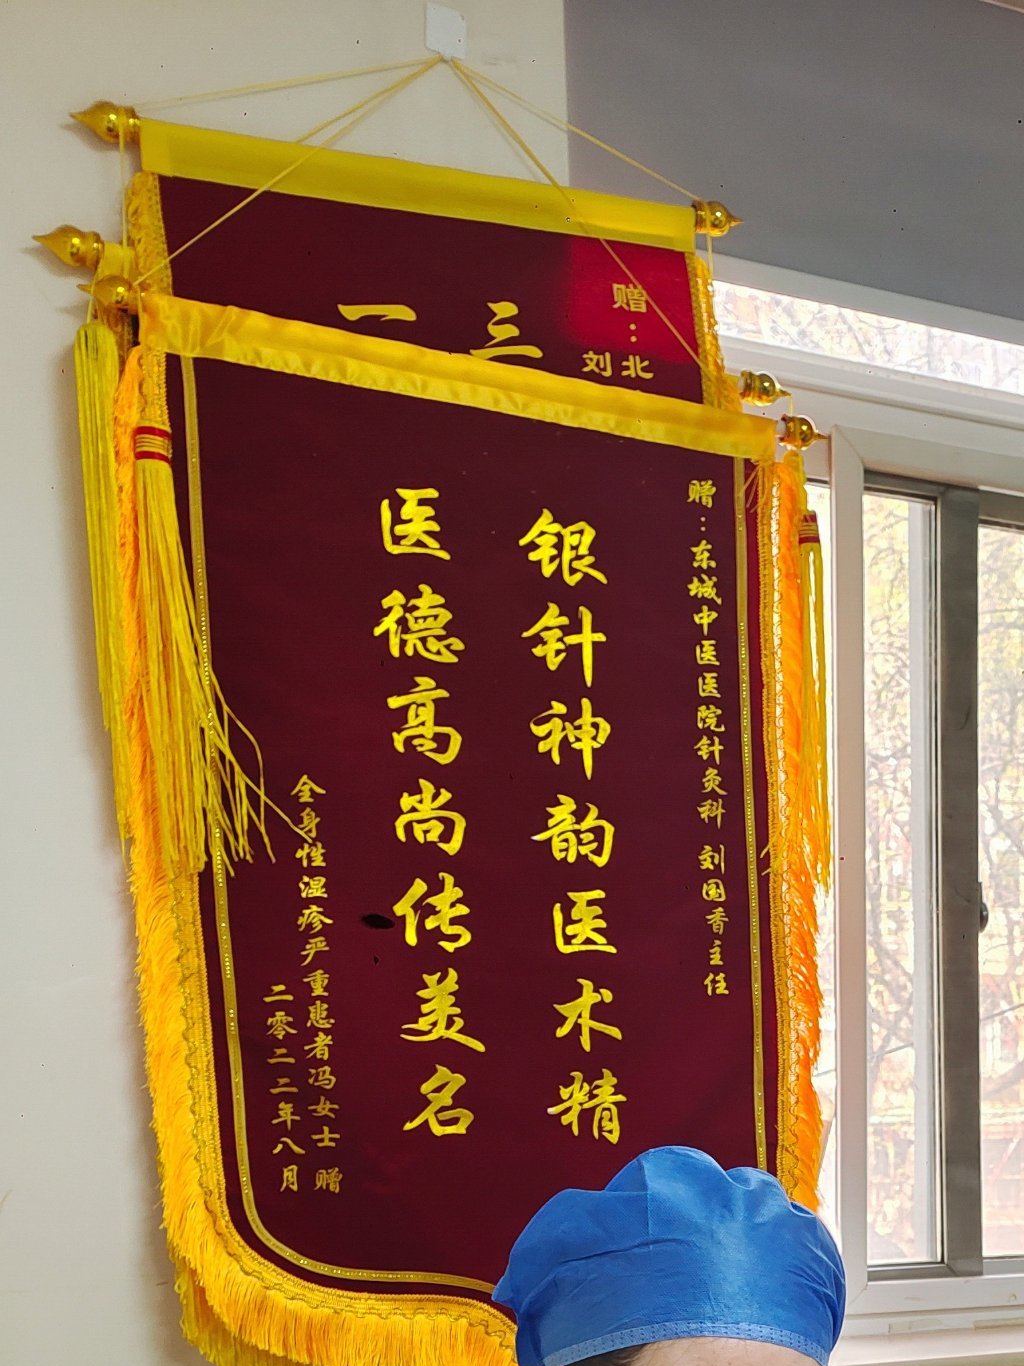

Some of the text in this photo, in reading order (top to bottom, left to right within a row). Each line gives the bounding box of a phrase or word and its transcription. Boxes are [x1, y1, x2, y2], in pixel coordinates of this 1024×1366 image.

[336, 303, 418, 322] 一
[469, 301, 544, 360] 三
[373, 487, 486, 1137] 医德高尚传美名
[518, 508, 627, 1145] 银针神韵医术精
[289, 773, 343, 1193] 全身性湿疹严重患者冯女士 赠
[697, 844, 731, 997] 刘国香主任
[262, 983, 307, 1193] 二零二二年八月
